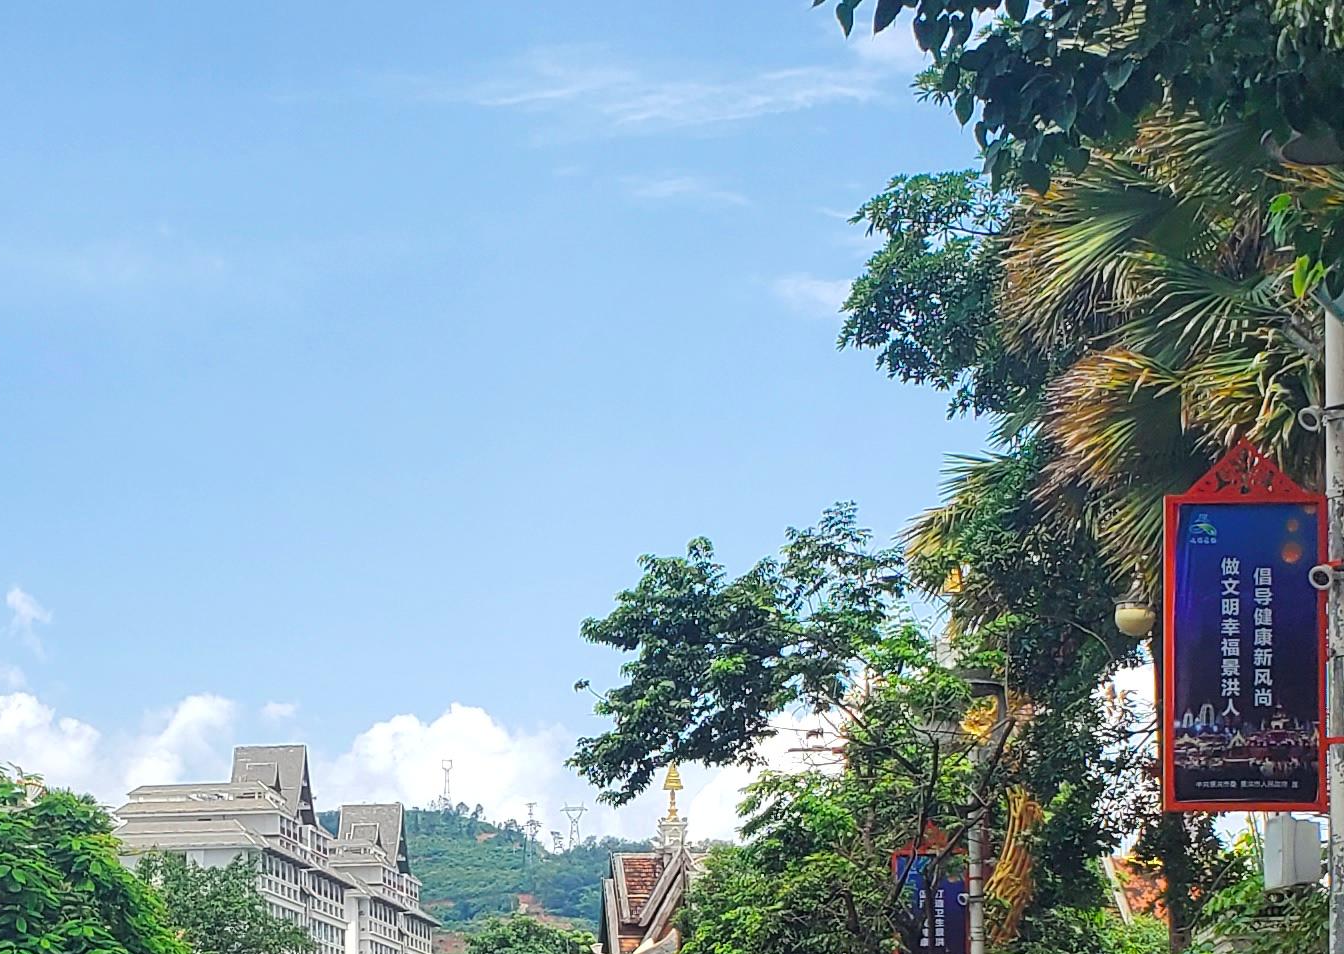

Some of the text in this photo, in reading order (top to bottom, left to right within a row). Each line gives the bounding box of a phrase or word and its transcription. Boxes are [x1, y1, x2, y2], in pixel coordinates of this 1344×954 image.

[1220, 556, 1241, 718] 做文明幸福景洪人
[1252, 567, 1273, 708] 倡导健康新风尚
